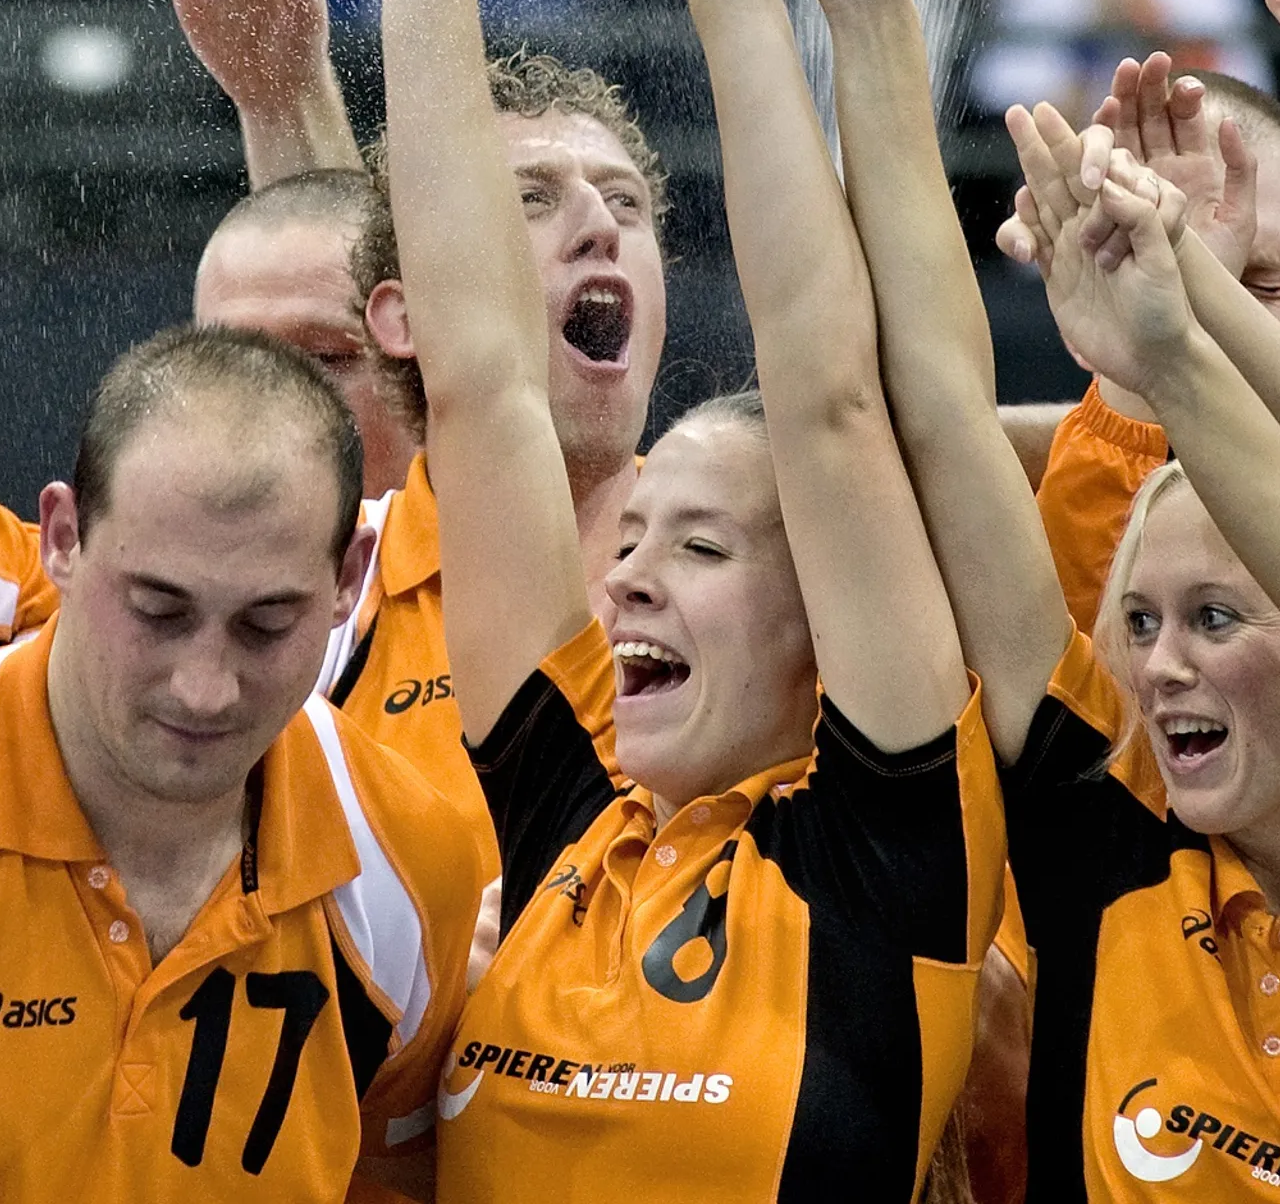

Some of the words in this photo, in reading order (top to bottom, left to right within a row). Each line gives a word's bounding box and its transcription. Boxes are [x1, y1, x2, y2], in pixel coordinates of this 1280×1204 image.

[642, 839, 739, 1004] 6
[2, 996, 78, 1029] asics
[171, 966, 331, 1177] 17
[458, 1041, 602, 1086] SPIEREN
[607, 1062, 636, 1074] VOOR
[565, 1071, 734, 1104] SPIEREN
